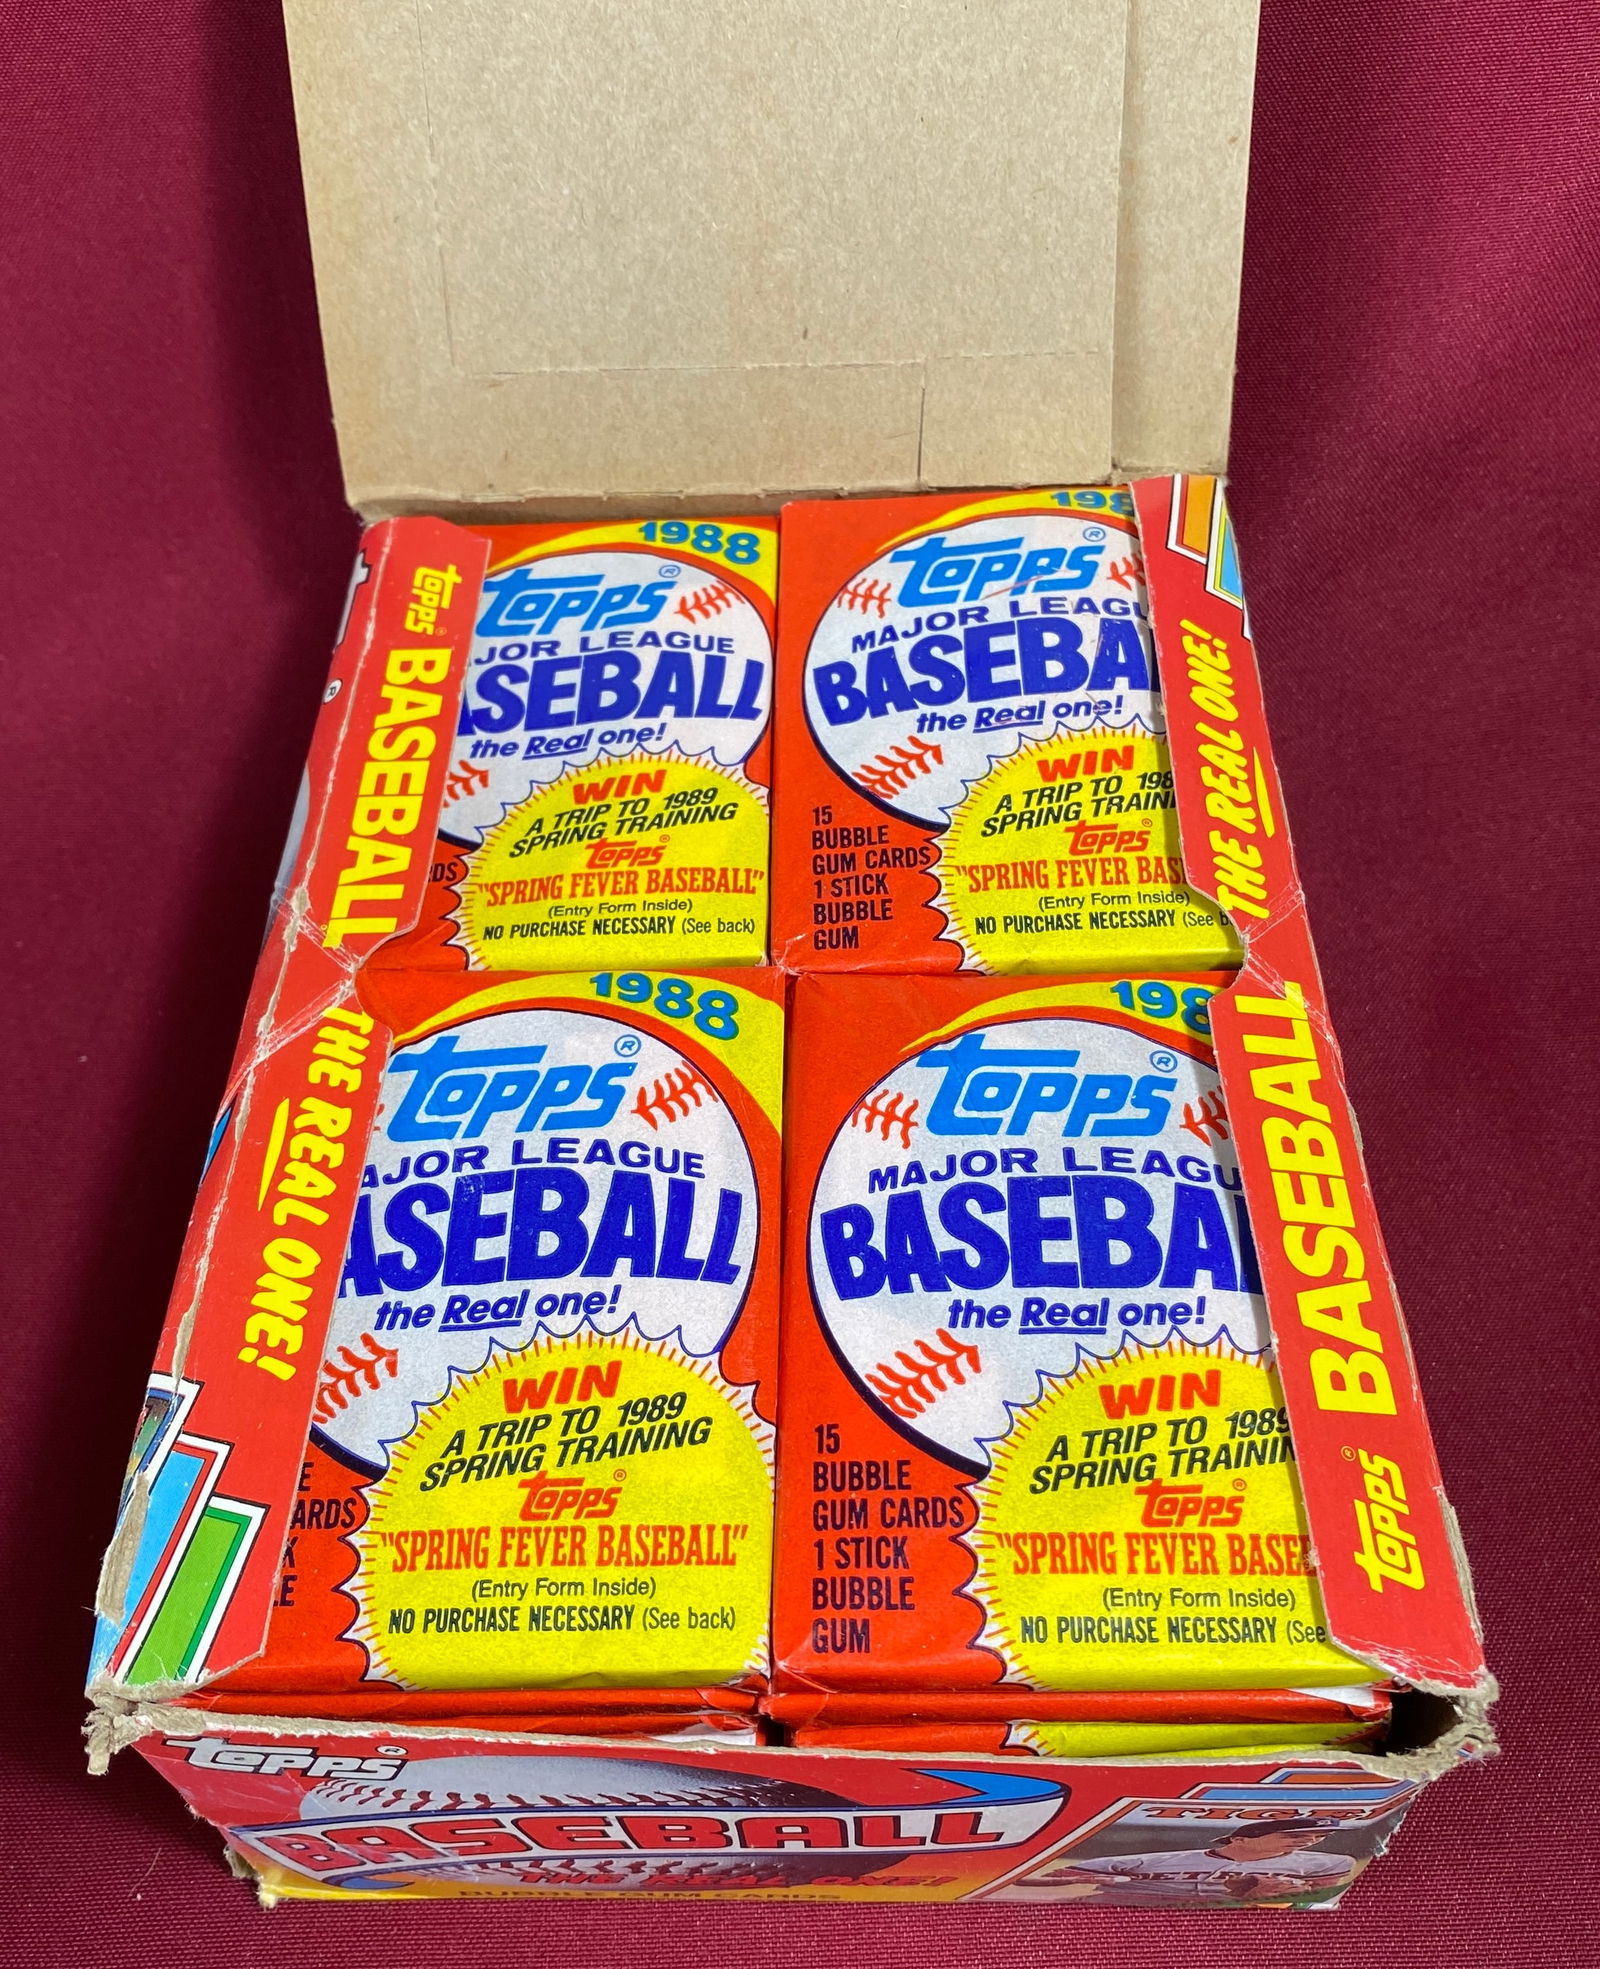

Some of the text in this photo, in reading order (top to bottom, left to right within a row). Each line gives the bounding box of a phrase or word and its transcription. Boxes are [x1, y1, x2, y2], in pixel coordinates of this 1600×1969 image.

[1050, 491, 1135, 517] 198
[639, 521, 760, 565] 1988
[851, 596, 1149, 654] MAJOR LEAGU
[469, 631, 735, 667] JOR LEAGUE
[813, 617, 1161, 727] BASEBA
[456, 650, 766, 737] SEBALL
[916, 695, 1123, 734] the Real one!
[470, 723, 666, 760] the Real one!
[1037, 745, 1135, 783] WIN
[1180, 618, 1270, 919] THE REAL ONE!
[323, 648, 452, 948] BASEBALL
[573, 770, 667, 805] WIN
[993, 770, 1174, 816] A TRIP TO 198
[509, 803, 738, 858] SPRING TRAINING
[526, 788, 718, 838] A TRIP TO 1989
[812, 806, 833, 826] 15
[980, 804, 1084, 838] SPRING
[811, 826, 889, 850] BUBBLE
[812, 845, 931, 875] GUM CARDS
[1056, 856, 1130, 888] FEVER
[571, 870, 637, 898] FEVER
[814, 875, 889, 899] 1 STICK
[1038, 890, 1190, 912] (Entry Form Inside)
[548, 898, 693, 920] (Entry Form Inside)
[813, 900, 894, 925] BUBBLE
[975, 917, 997, 935] NO
[1003, 913, 1083, 933] PURCHASE
[1090, 909, 1176, 930] NECESSARY
[1182, 911, 1214, 928] (See
[483, 917, 756, 941] NO PURCHASE NECESSARY (See back)
[813, 927, 860, 951] GUM
[589, 971, 740, 1040] 1988
[1111, 979, 1212, 1035] 198
[361, 1138, 705, 1188] AJOR LEAGUE
[869, 1146, 1241, 1193] MAJOR LEAGU
[237, 1005, 375, 1381] THE REAL ONE!
[1234, 981, 1397, 1417] BASEBALL
[338, 1166, 742, 1299] ASEBALL
[374, 1285, 620, 1332] the Real one!
[948, 1296, 1206, 1335] the Real one!
[503, 1360, 623, 1415] WIN
[1099, 1369, 1221, 1421] WIN
[440, 1391, 687, 1460] A TRIP TO 1989
[814, 1424, 840, 1454] 15
[1045, 1435, 1071, 1463] A
[1082, 1424, 1159, 1458] TRIP
[1167, 1415, 1208, 1447] TO
[419, 1416, 713, 1492] SPRING TRAINING
[1028, 1436, 1296, 1496] SPRING TRAININ
[813, 1460, 911, 1493] BUBBLE
[290, 1497, 358, 1531] ARDS
[812, 1496, 966, 1531] GUM CARDS
[499, 1526, 587, 1570] FEVER
[815, 1539, 909, 1570] 1 STICK
[1126, 1532, 1219, 1577] FEVER
[471, 1575, 657, 1603] (Entry Form Inside)
[812, 1577, 915, 1611] BUBBLE
[1102, 1587, 1297, 1612] (Entry Form Inside)
[388, 1604, 737, 1634] NO PURCHASE NECESSARY (See back)
[812, 1619, 871, 1654] GUM
[1020, 1616, 1326, 1645] NO PURCHASE NECESSARY (See
[257, 1813, 1010, 1871] BASEBALL
[520, 1872, 629, 1884] THE
